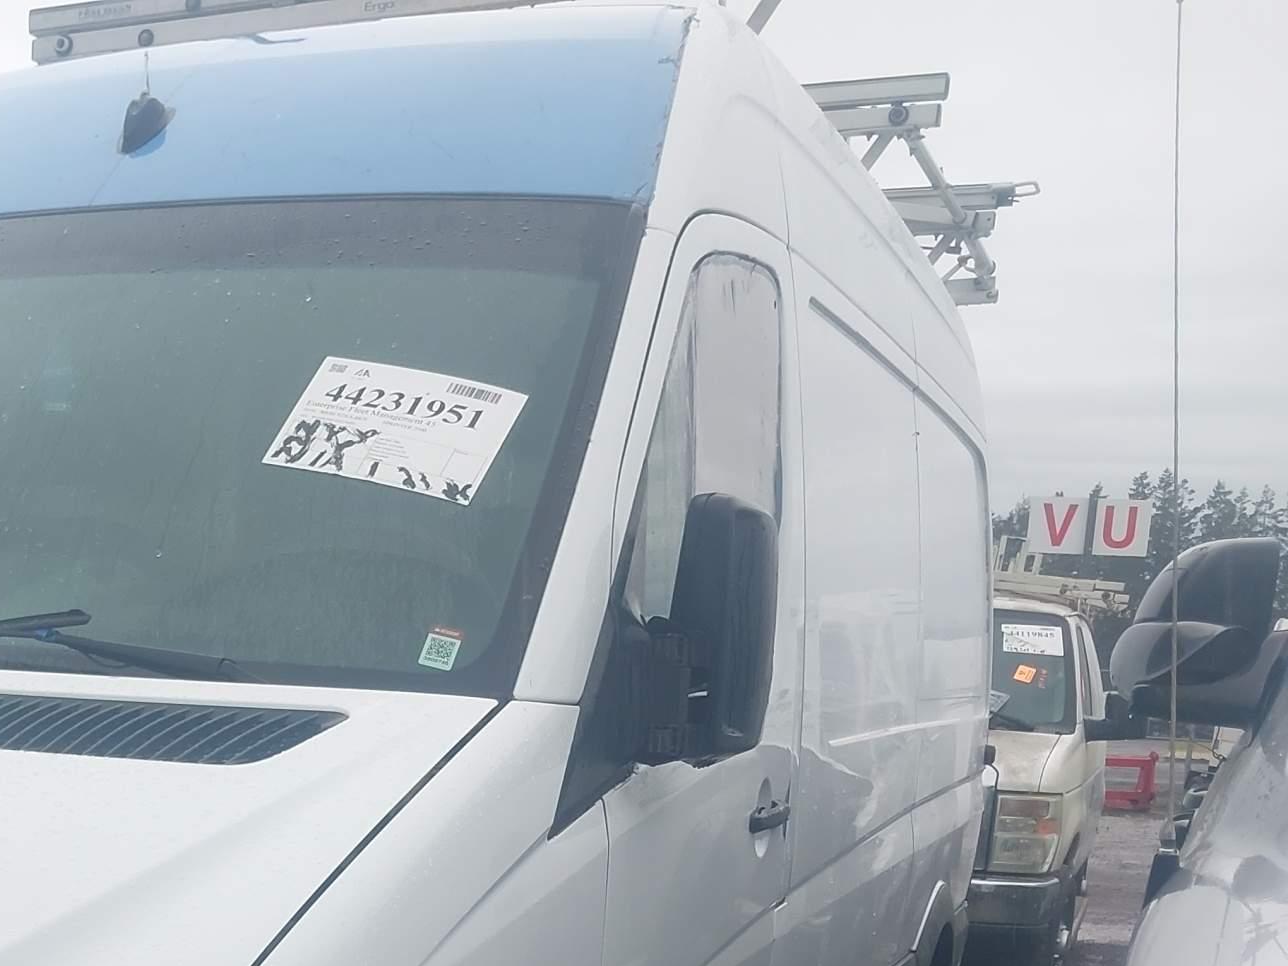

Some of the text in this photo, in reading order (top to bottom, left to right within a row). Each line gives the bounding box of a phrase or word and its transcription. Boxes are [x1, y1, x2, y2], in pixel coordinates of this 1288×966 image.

[325, 383, 485, 431] 44231951
[1043, 502, 1139, 550] V U
